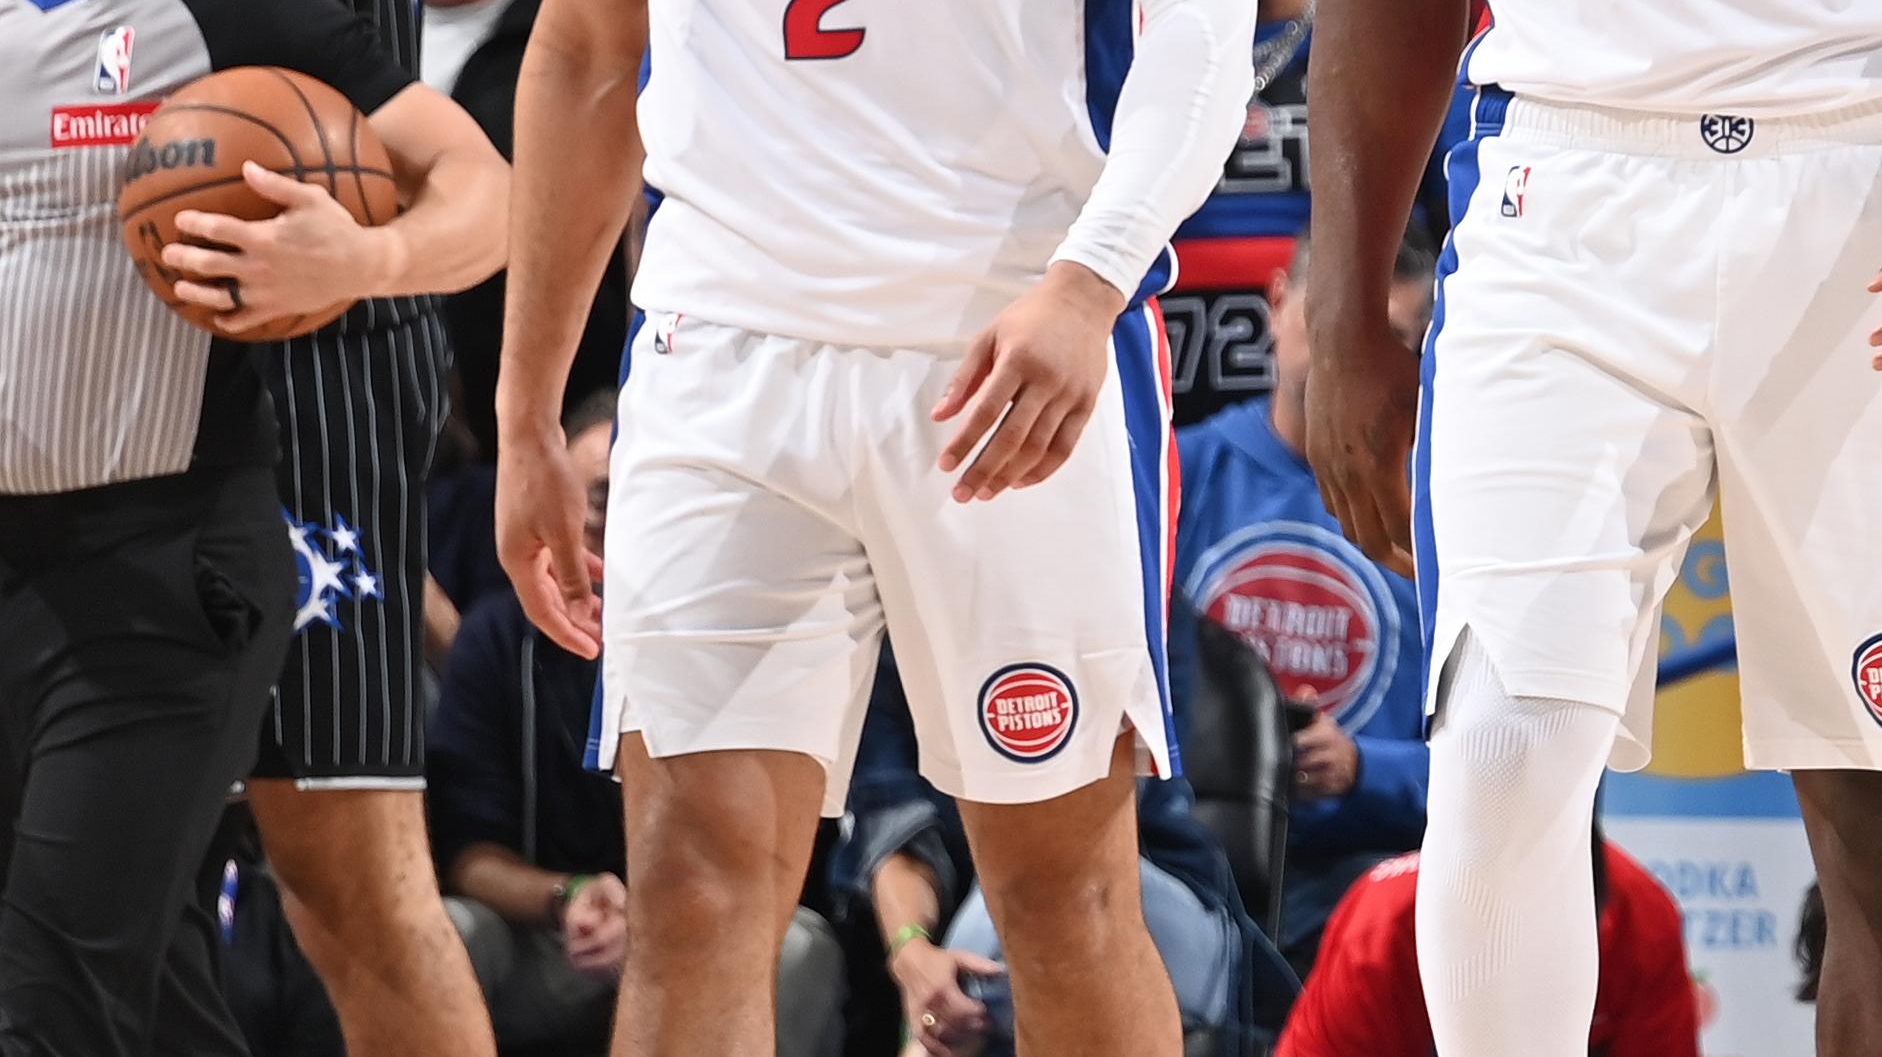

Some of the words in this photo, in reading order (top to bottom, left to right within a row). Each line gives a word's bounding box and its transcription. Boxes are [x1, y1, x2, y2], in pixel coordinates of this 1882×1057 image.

[53, 110, 151, 142] Emirat
[996, 691, 1058, 715] DETROIT
[998, 708, 1062, 732] PISTONS
